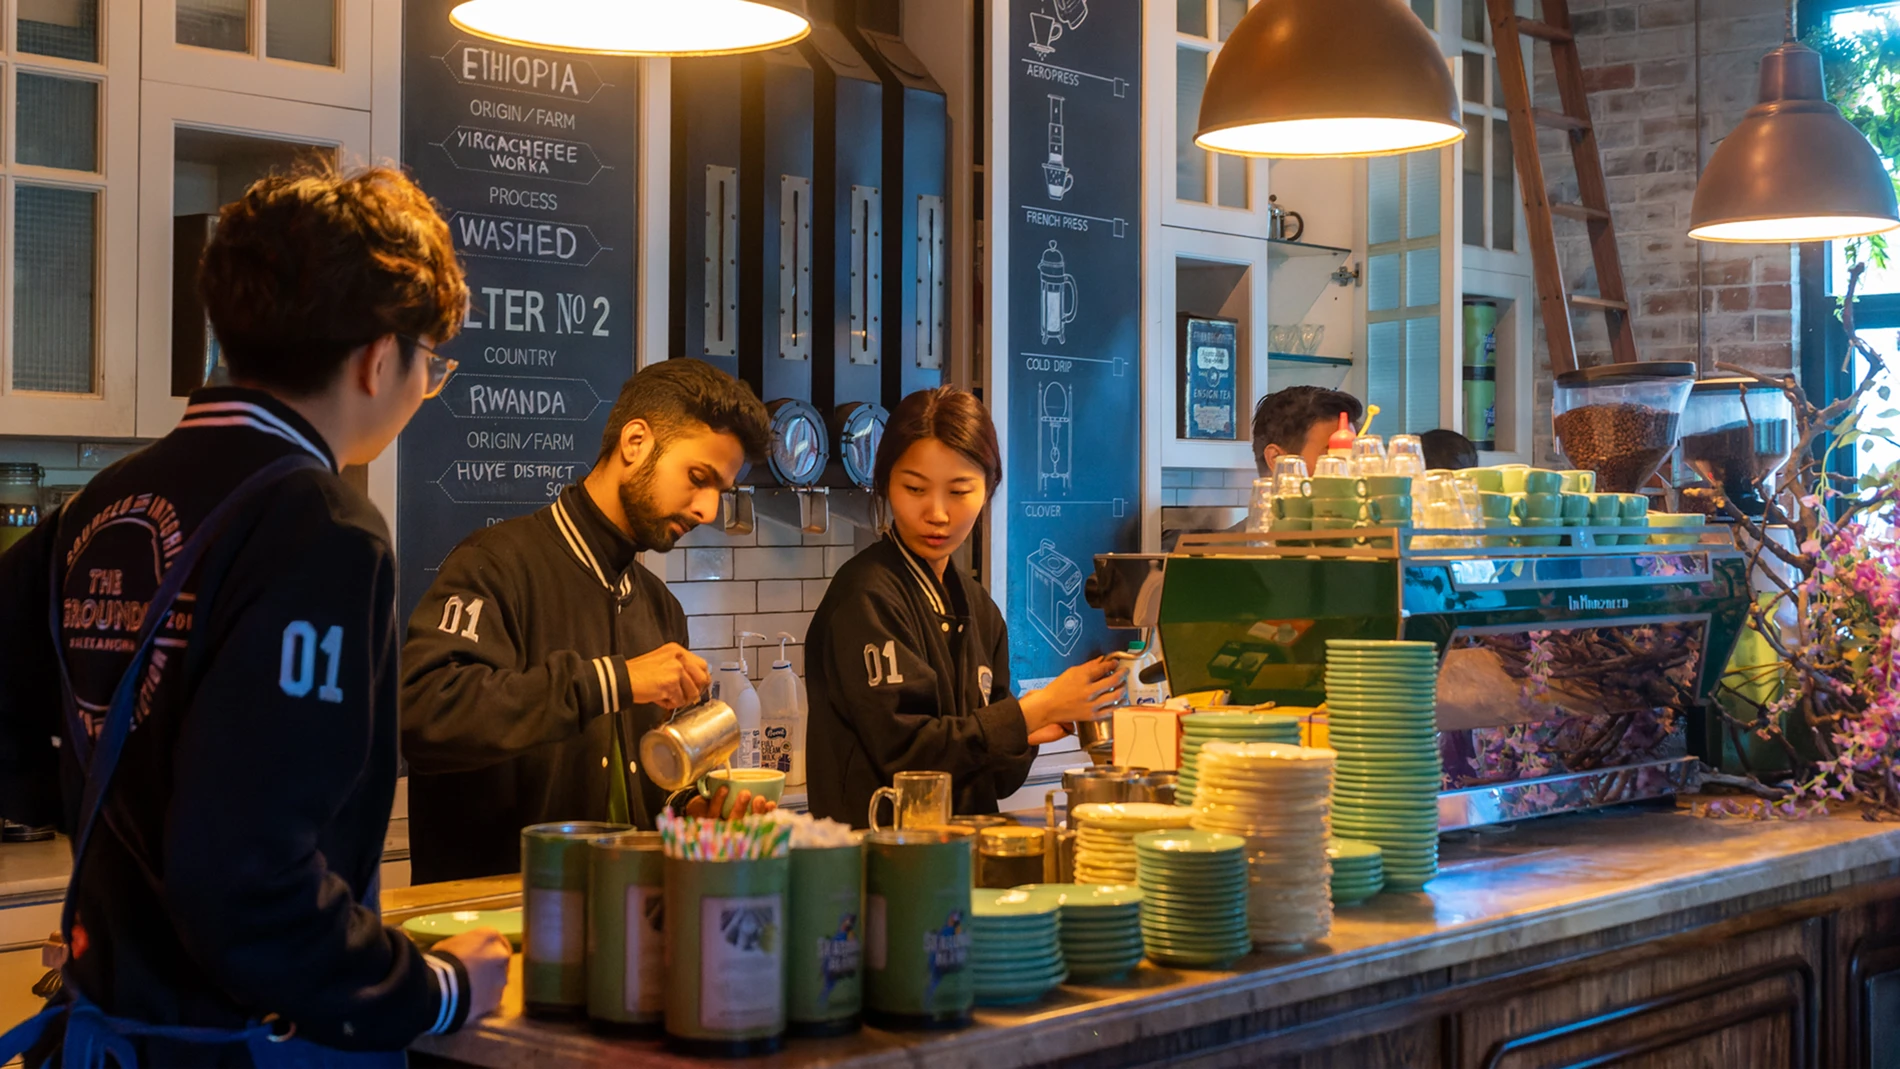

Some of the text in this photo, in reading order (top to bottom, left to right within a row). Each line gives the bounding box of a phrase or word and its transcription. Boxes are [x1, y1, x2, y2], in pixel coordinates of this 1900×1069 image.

[462, 47, 579, 95] ETHIOPIA
[1027, 64, 1079, 86] AEROPRESS
[457, 131, 578, 163] YIRGACHEFEE
[490, 154, 549, 174] WORKA
[489, 187, 558, 211] PROCESS
[1027, 211, 1088, 232] FRENCH PRESS
[459, 217, 577, 259] WASHED
[463, 286, 546, 333] LTER
[592, 296, 610, 337] 2
[484, 347, 557, 367] COUNTRY
[1026, 358, 1072, 373] COLD DRIP
[469, 384, 565, 415] RWANDA
[467, 431, 574, 451] ORIGIN/FARM
[457, 462, 575, 481] HUYE DISTRICT
[1025, 505, 1061, 518] CLOVER
[89, 568, 123, 595] THE
[437, 595, 484, 643] 01
[279, 620, 344, 703] 01
[863, 640, 903, 687] 01
